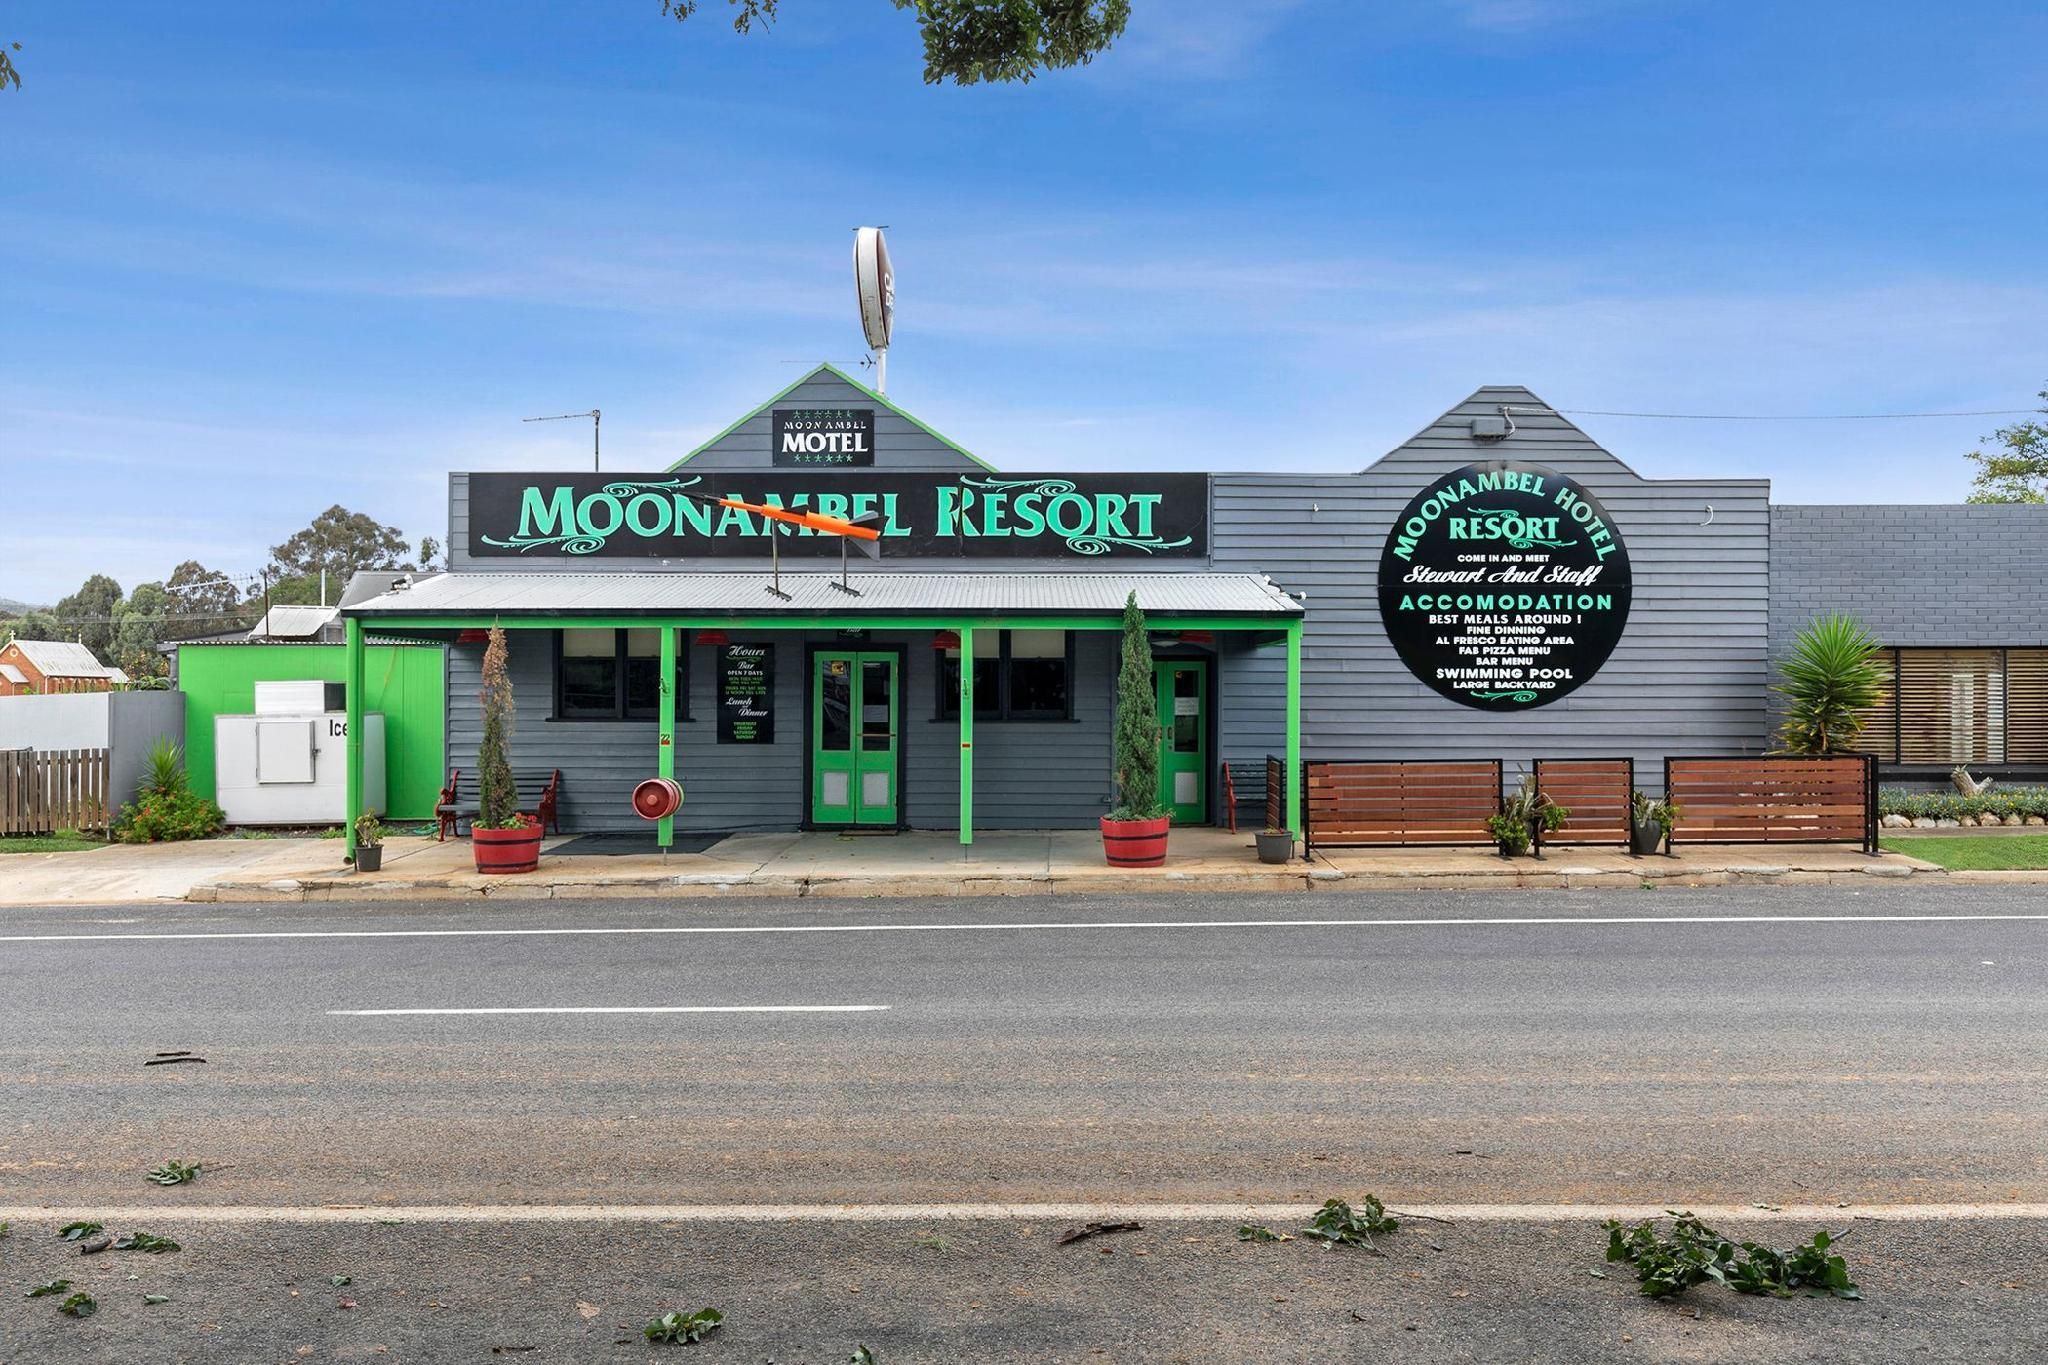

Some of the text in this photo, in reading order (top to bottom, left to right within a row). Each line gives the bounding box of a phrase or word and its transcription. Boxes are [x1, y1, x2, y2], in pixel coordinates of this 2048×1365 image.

[782, 432, 869, 453] MOTEL
[935, 486, 1163, 538] RESORT
[1393, 471, 1616, 562] MOONAMBEL HOTEL
[1449, 517, 1560, 540] RESORT
[1457, 554, 1550, 563] COME IN AND MEET
[1403, 565, 1604, 586] Stewart And Staff
[1399, 594, 1612, 610] ACCOMODATION
[1429, 614, 1459, 624] BEST
[1464, 614, 1509, 624] MEALS
[1514, 614, 1572, 624] AROUND
[1467, 626, 1546, 634] FINE DINNING
[1436, 636, 1575, 645] AL FRESCO EATING AREA
[728, 645, 765, 656] Hours
[1458, 646, 1551, 655] FAB PIZZA MENU
[1476, 657, 1534, 666] BAR MENU
[1436, 668, 1573, 679] SWIMMING POOL
[1453, 681, 1556, 689] LARGE BACKYARD
[725, 697, 753, 705] Lunch
[738, 708, 768, 717] Dinner
[329, 719, 348, 737] Ice
